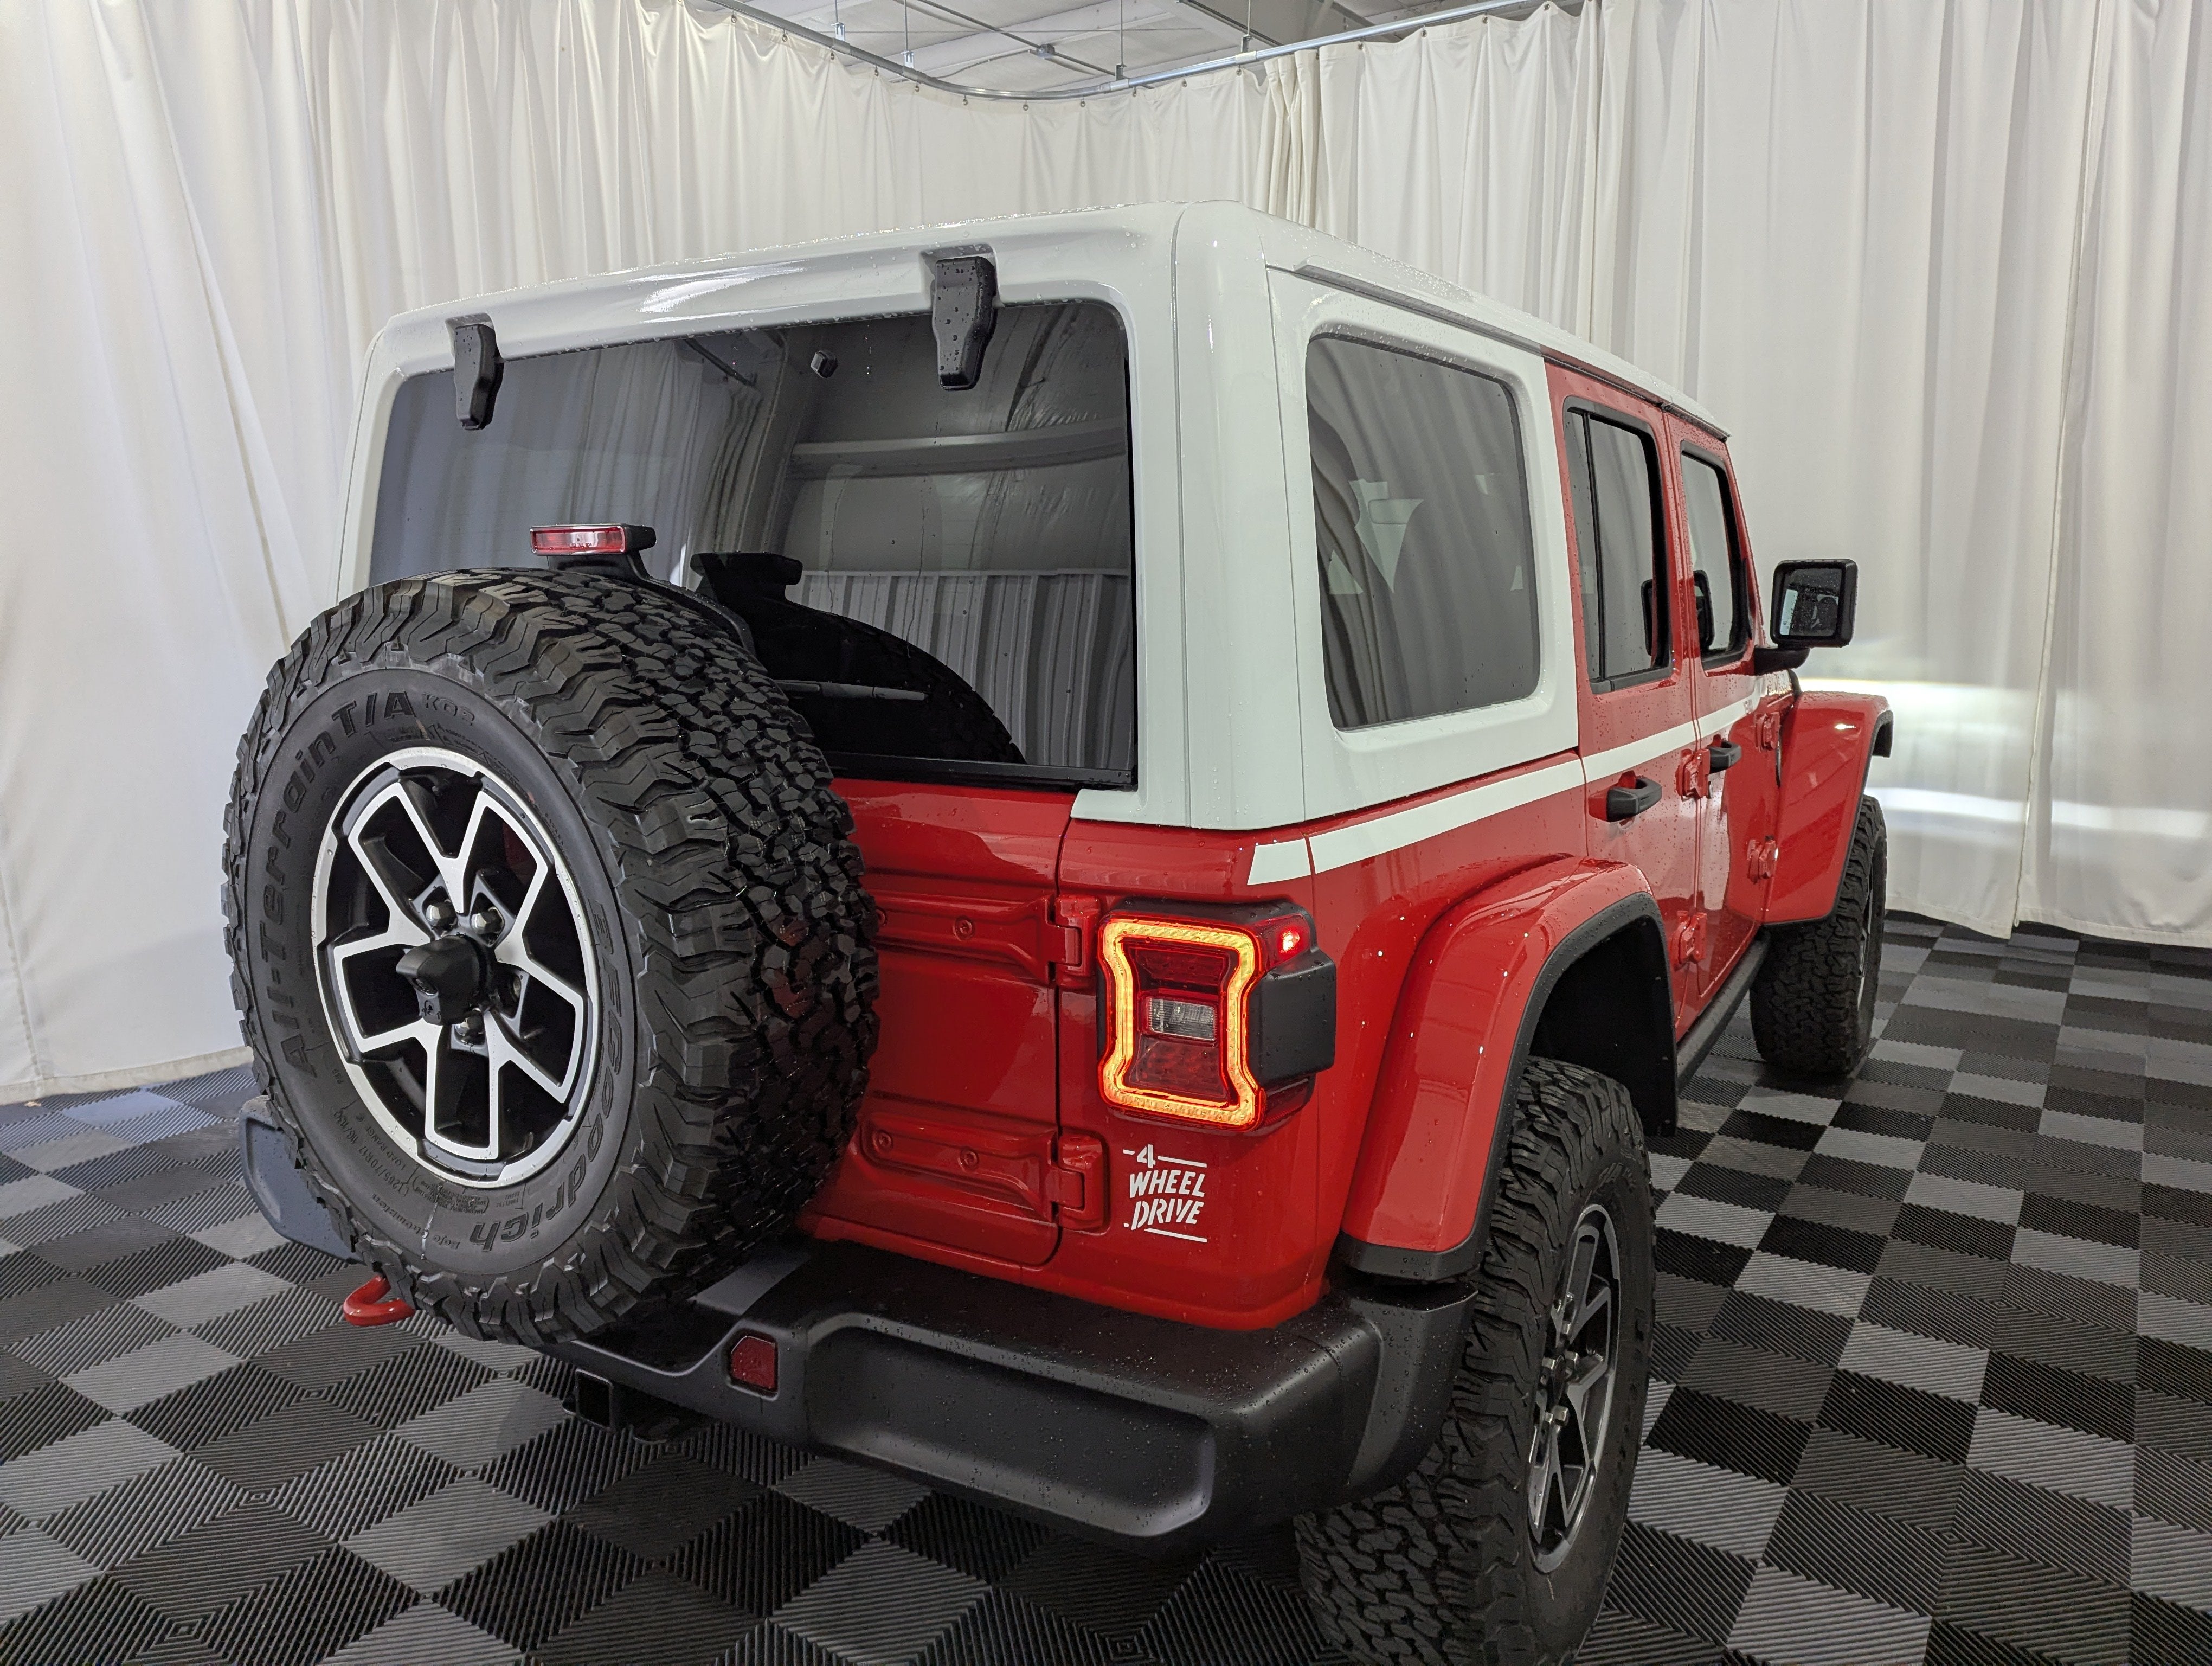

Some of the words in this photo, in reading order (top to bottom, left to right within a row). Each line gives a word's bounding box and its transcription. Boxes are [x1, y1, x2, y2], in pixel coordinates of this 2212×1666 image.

[259, 732, 335, 1079] All-Terrain
[332, 689, 417, 739] T/A
[469, 899, 623, 1252] BFGoodrich
[1137, 1144, 1156, 1168] 4
[1130, 1169, 1205, 1198] WHEEL
[1131, 1198, 1205, 1231] DRIVE
